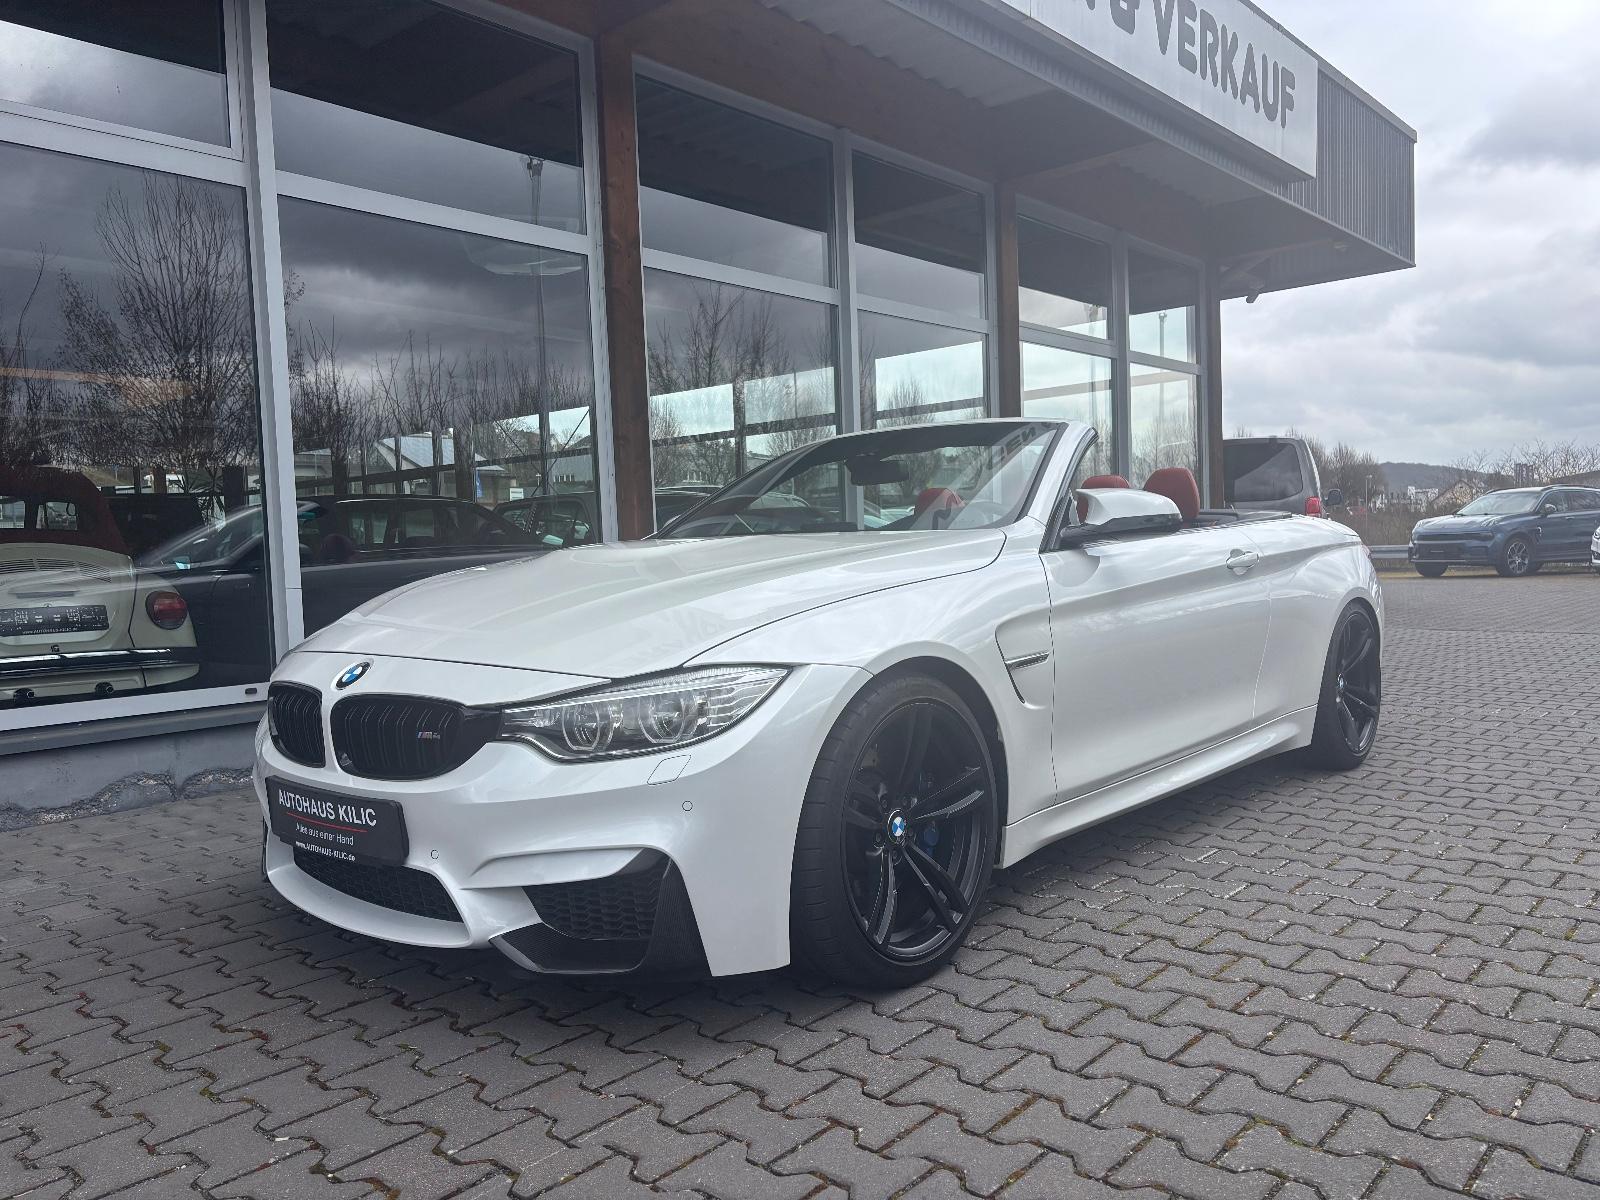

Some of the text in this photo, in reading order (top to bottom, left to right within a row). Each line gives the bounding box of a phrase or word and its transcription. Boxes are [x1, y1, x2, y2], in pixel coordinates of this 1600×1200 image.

[1153, 0, 1296, 129] VERKAUF
[278, 789, 377, 827] AUTOHAUS KILIC
[336, 833, 354, 846] Hand
